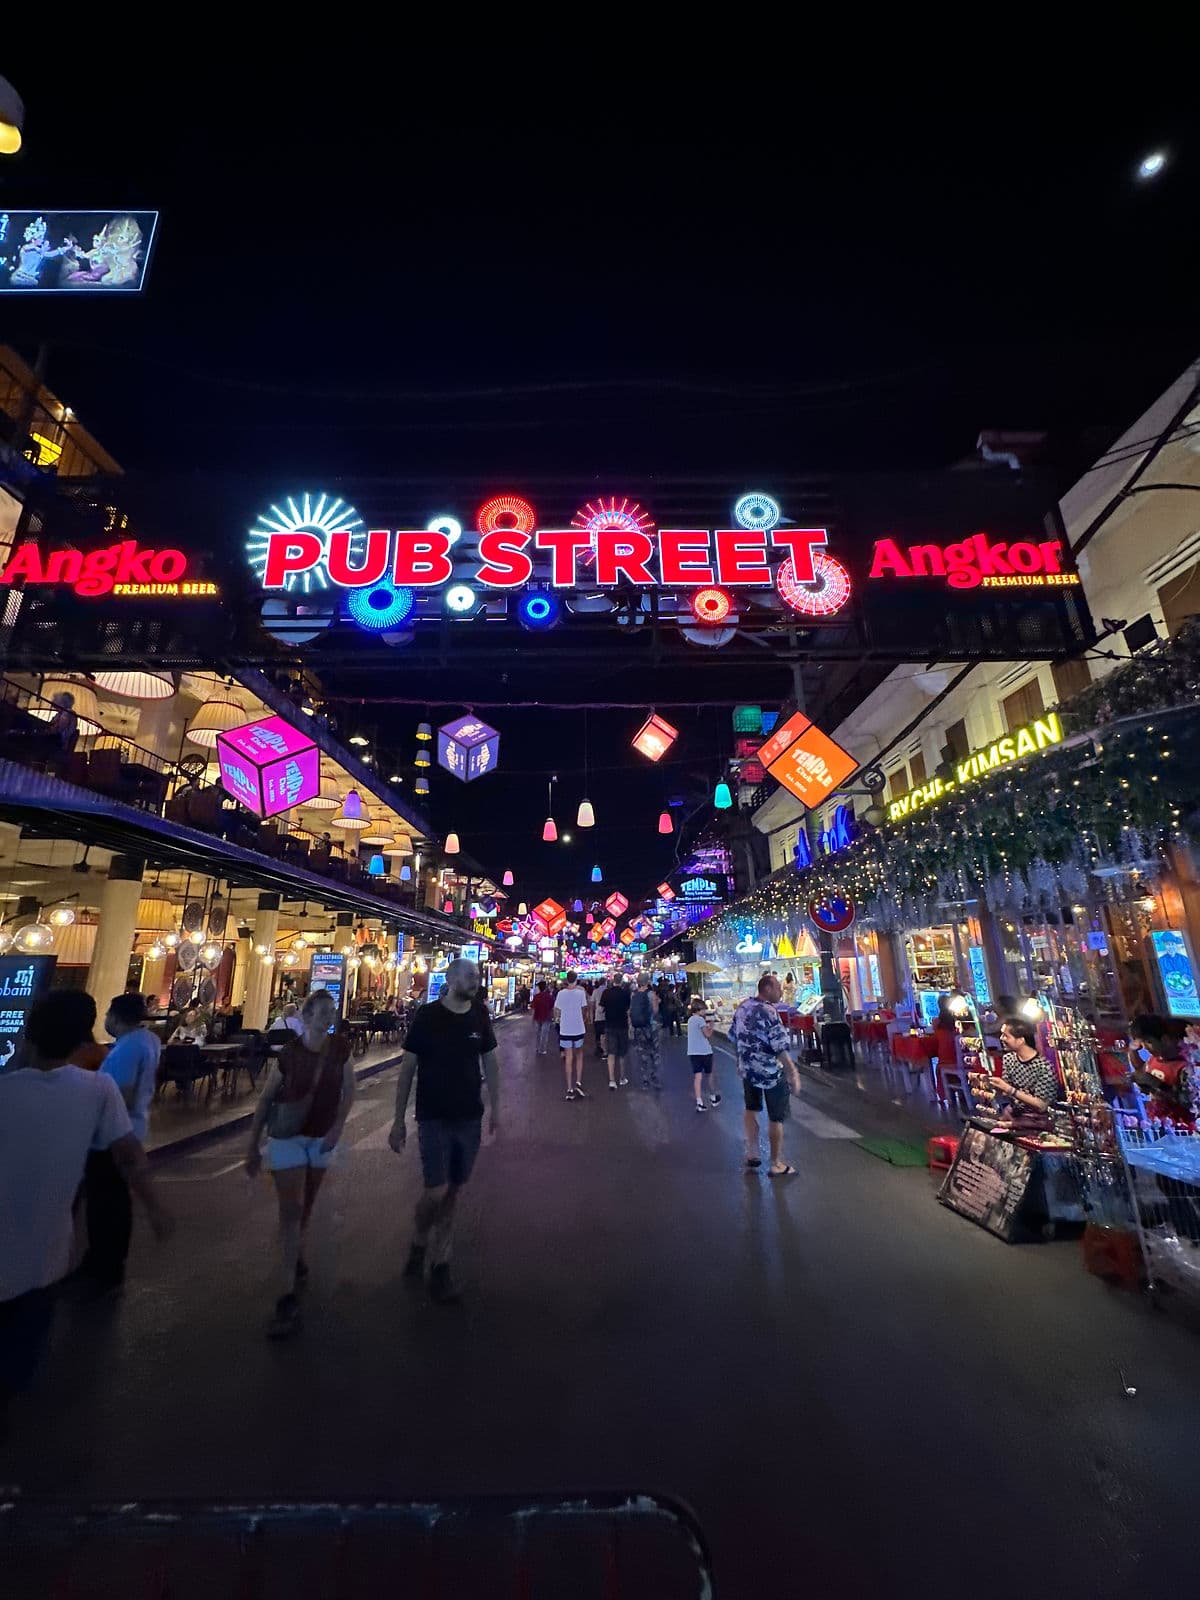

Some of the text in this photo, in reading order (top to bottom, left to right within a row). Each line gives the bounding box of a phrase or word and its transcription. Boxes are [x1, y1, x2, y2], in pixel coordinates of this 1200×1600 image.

[0, 540, 187, 596] Angko
[263, 528, 829, 588] PUB STREET
[868, 533, 1062, 589] Angkor
[113, 583, 217, 595] PREMIUM BEER
[982, 574, 1079, 587] PREMIUM BEER
[248, 726, 289, 754] TEMPLE
[957, 712, 1063, 784] KIMSAN
[223, 763, 257, 796] TEMPLE
[285, 760, 304, 805] TEMPLE
[791, 748, 833, 788] TEMPLE
[796, 766, 813, 783] Club
[680, 877, 717, 891] TEMPLE
[0, 1011, 24, 1019] FREE
